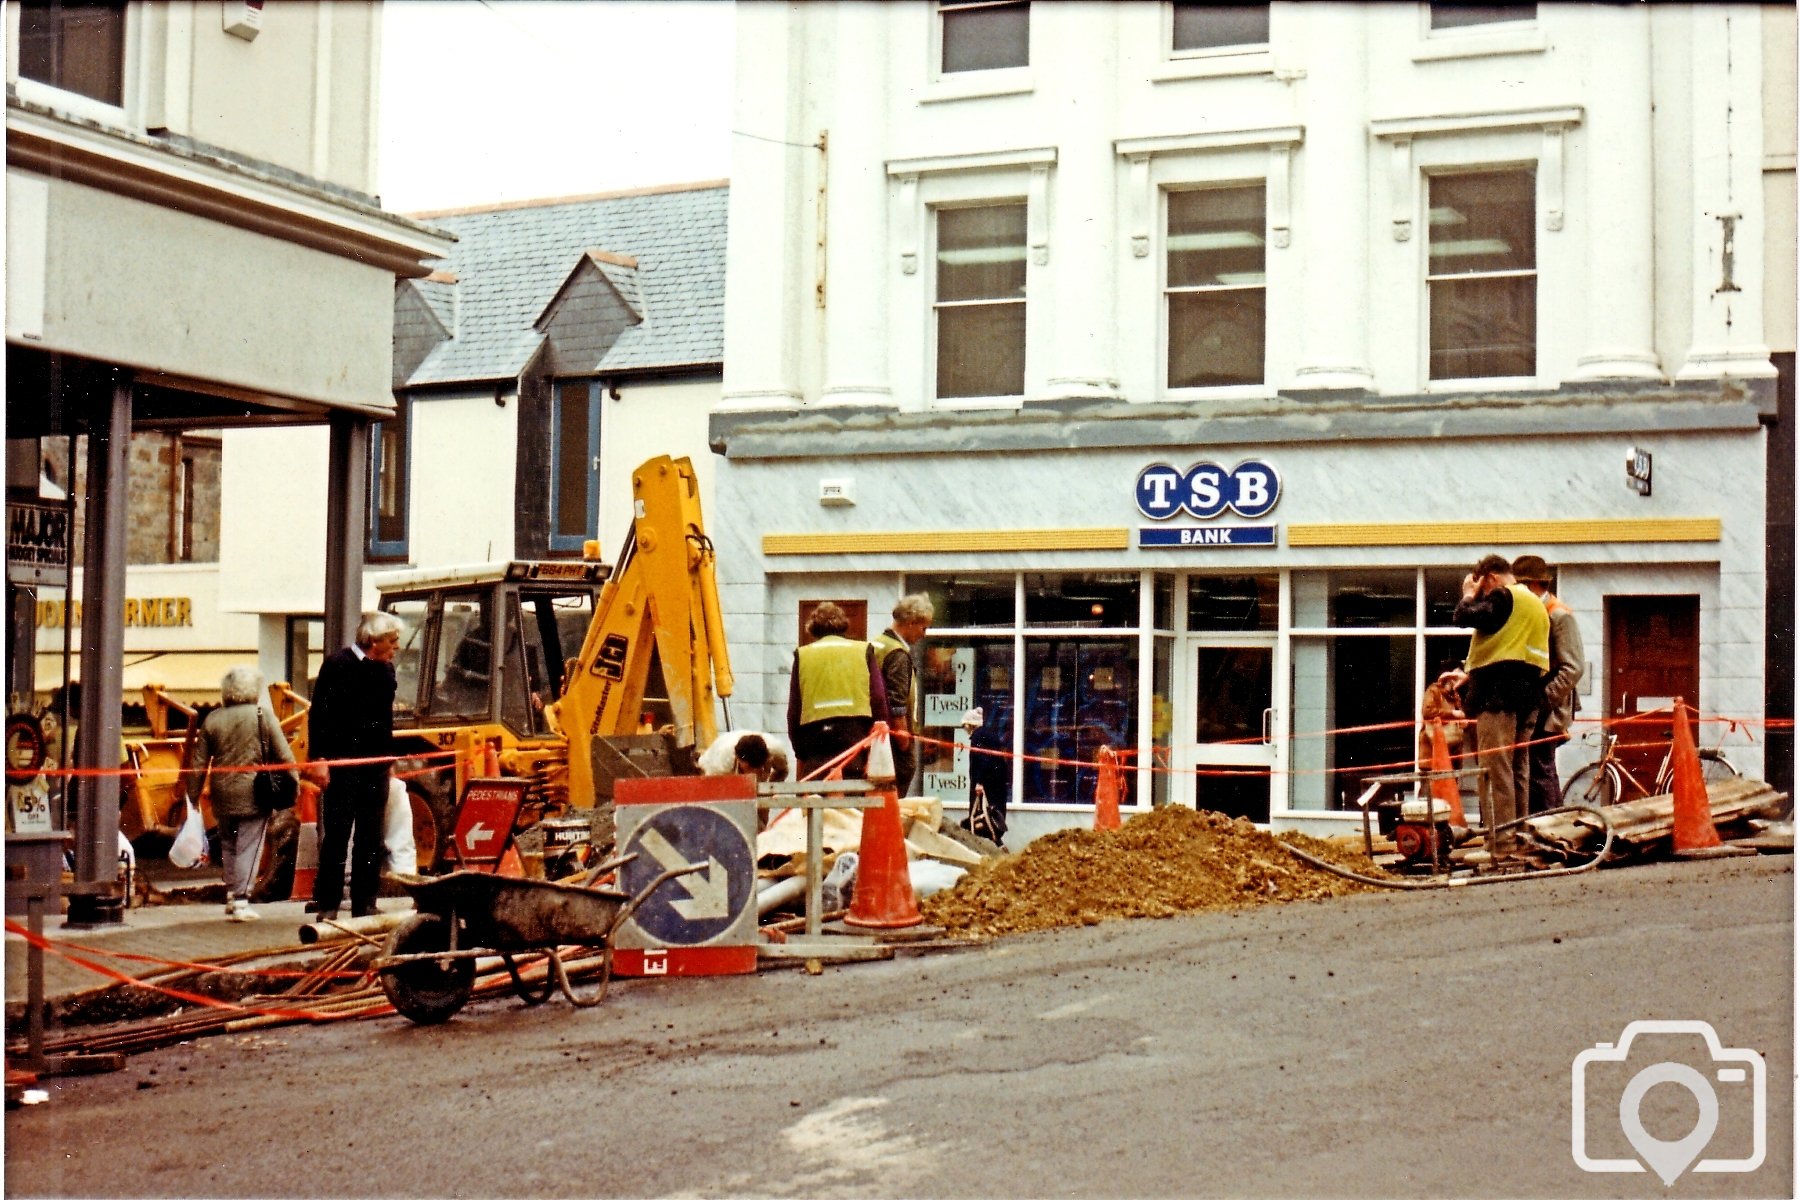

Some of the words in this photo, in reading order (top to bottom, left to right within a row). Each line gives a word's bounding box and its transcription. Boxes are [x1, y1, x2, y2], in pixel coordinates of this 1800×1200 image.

[1144, 471, 1269, 508] TSB
[9, 508, 66, 548] MAJOR
[1180, 529, 1232, 544] BANK
[124, 598, 193, 627] RMER
[930, 696, 969, 715] TyesB
[928, 775, 967, 793] TyesB
[467, 789, 519, 801] PEDESTRIANS
